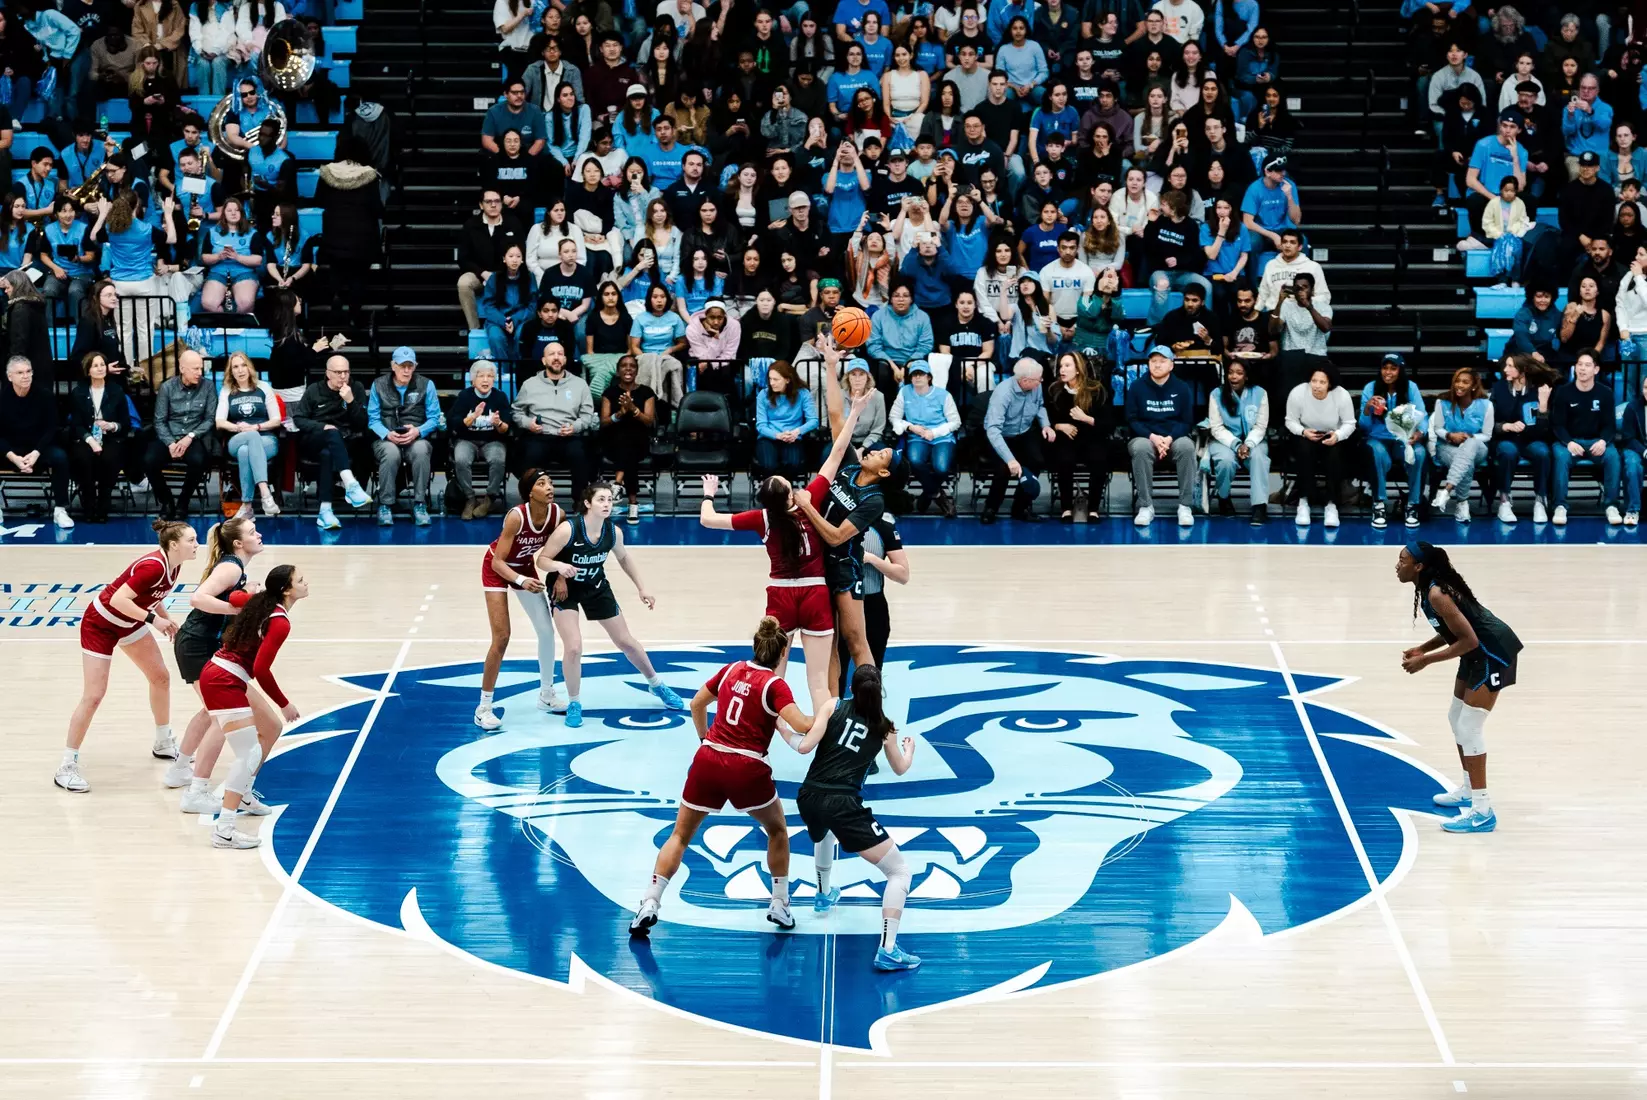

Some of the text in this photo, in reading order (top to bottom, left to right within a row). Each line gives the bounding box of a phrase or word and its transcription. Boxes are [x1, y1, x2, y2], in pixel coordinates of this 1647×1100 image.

[572, 552, 608, 565] Columbia
[574, 567, 600, 582] 24
[1490, 672, 1500, 687] C
[731, 680, 752, 696] JONES
[726, 696, 744, 726] 0
[837, 717, 869, 753] 12
[871, 821, 884, 837] C
